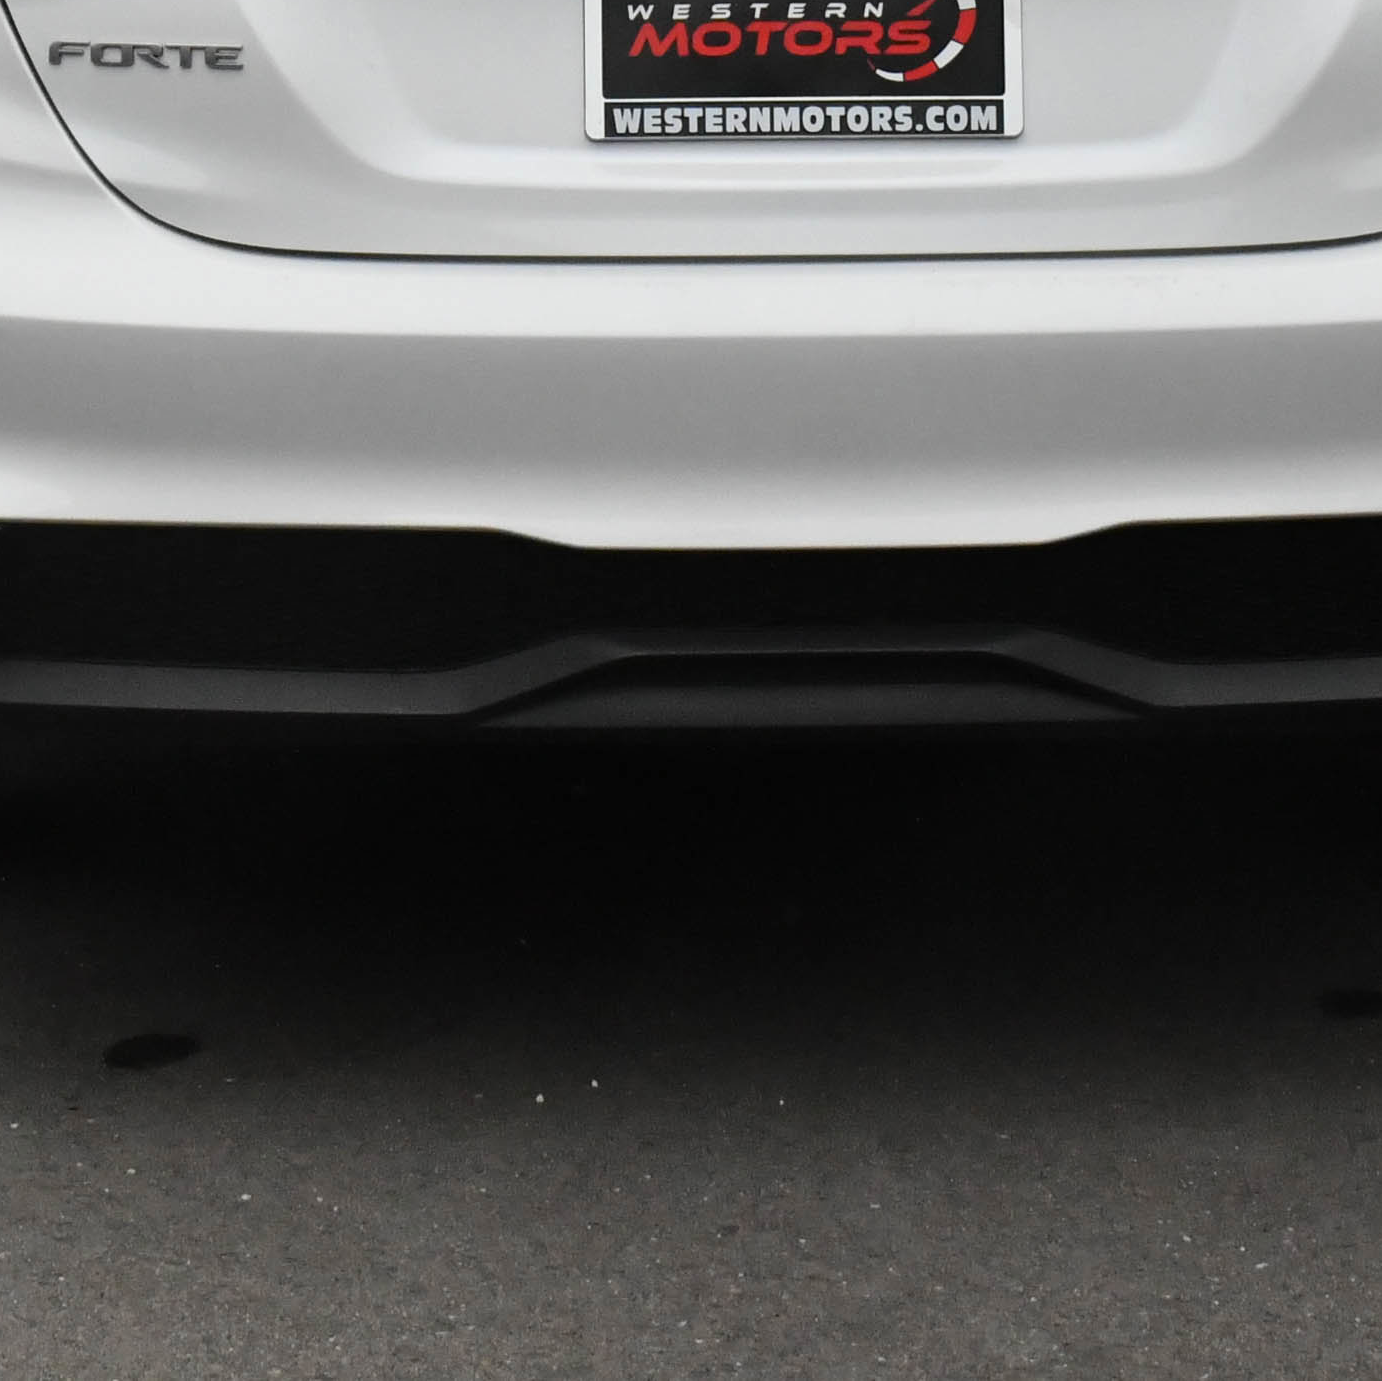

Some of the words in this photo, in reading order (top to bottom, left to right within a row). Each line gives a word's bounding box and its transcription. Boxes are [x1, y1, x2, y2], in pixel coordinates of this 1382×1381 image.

[626, 2, 885, 21] WESTERN
[628, 20, 932, 57] MOTORS
[48, 41, 244, 70] FORTE
[612, 105, 998, 134] WESTERNMOTORS.COM
